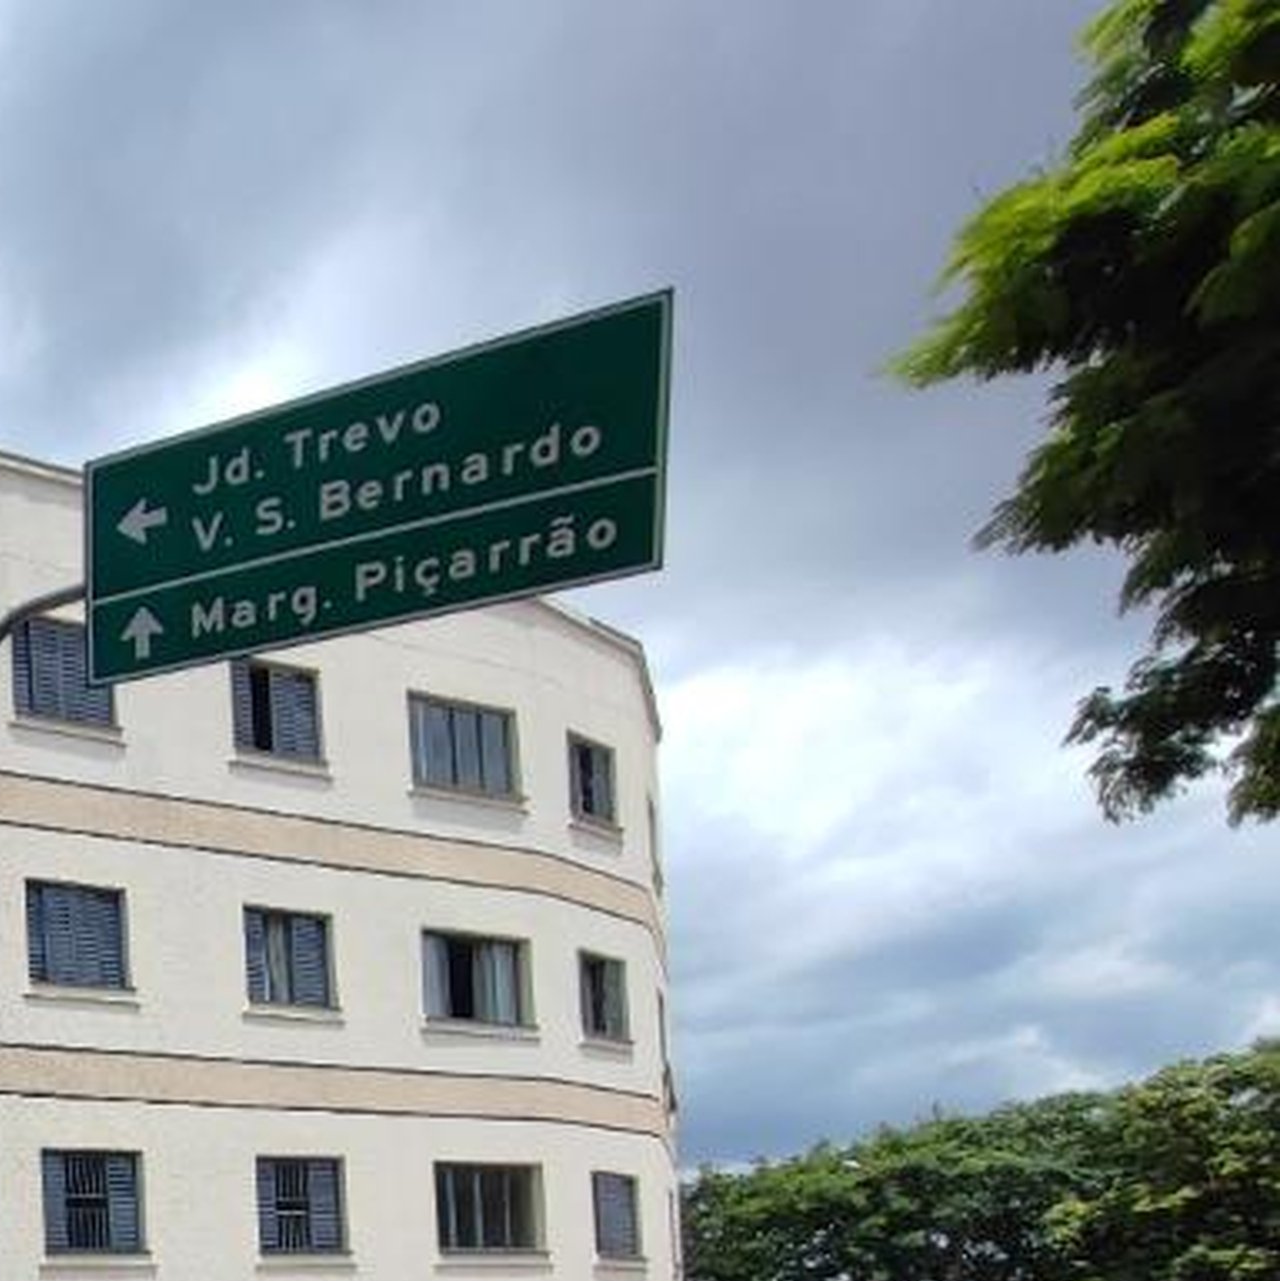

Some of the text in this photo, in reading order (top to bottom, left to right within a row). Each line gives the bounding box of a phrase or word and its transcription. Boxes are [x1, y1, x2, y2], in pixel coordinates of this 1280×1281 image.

[191, 421, 603, 552] V. S. Bernardo
[192, 399, 441, 496] Jd. Trevo
[190, 513, 618, 639] Marg. Piçarrão
